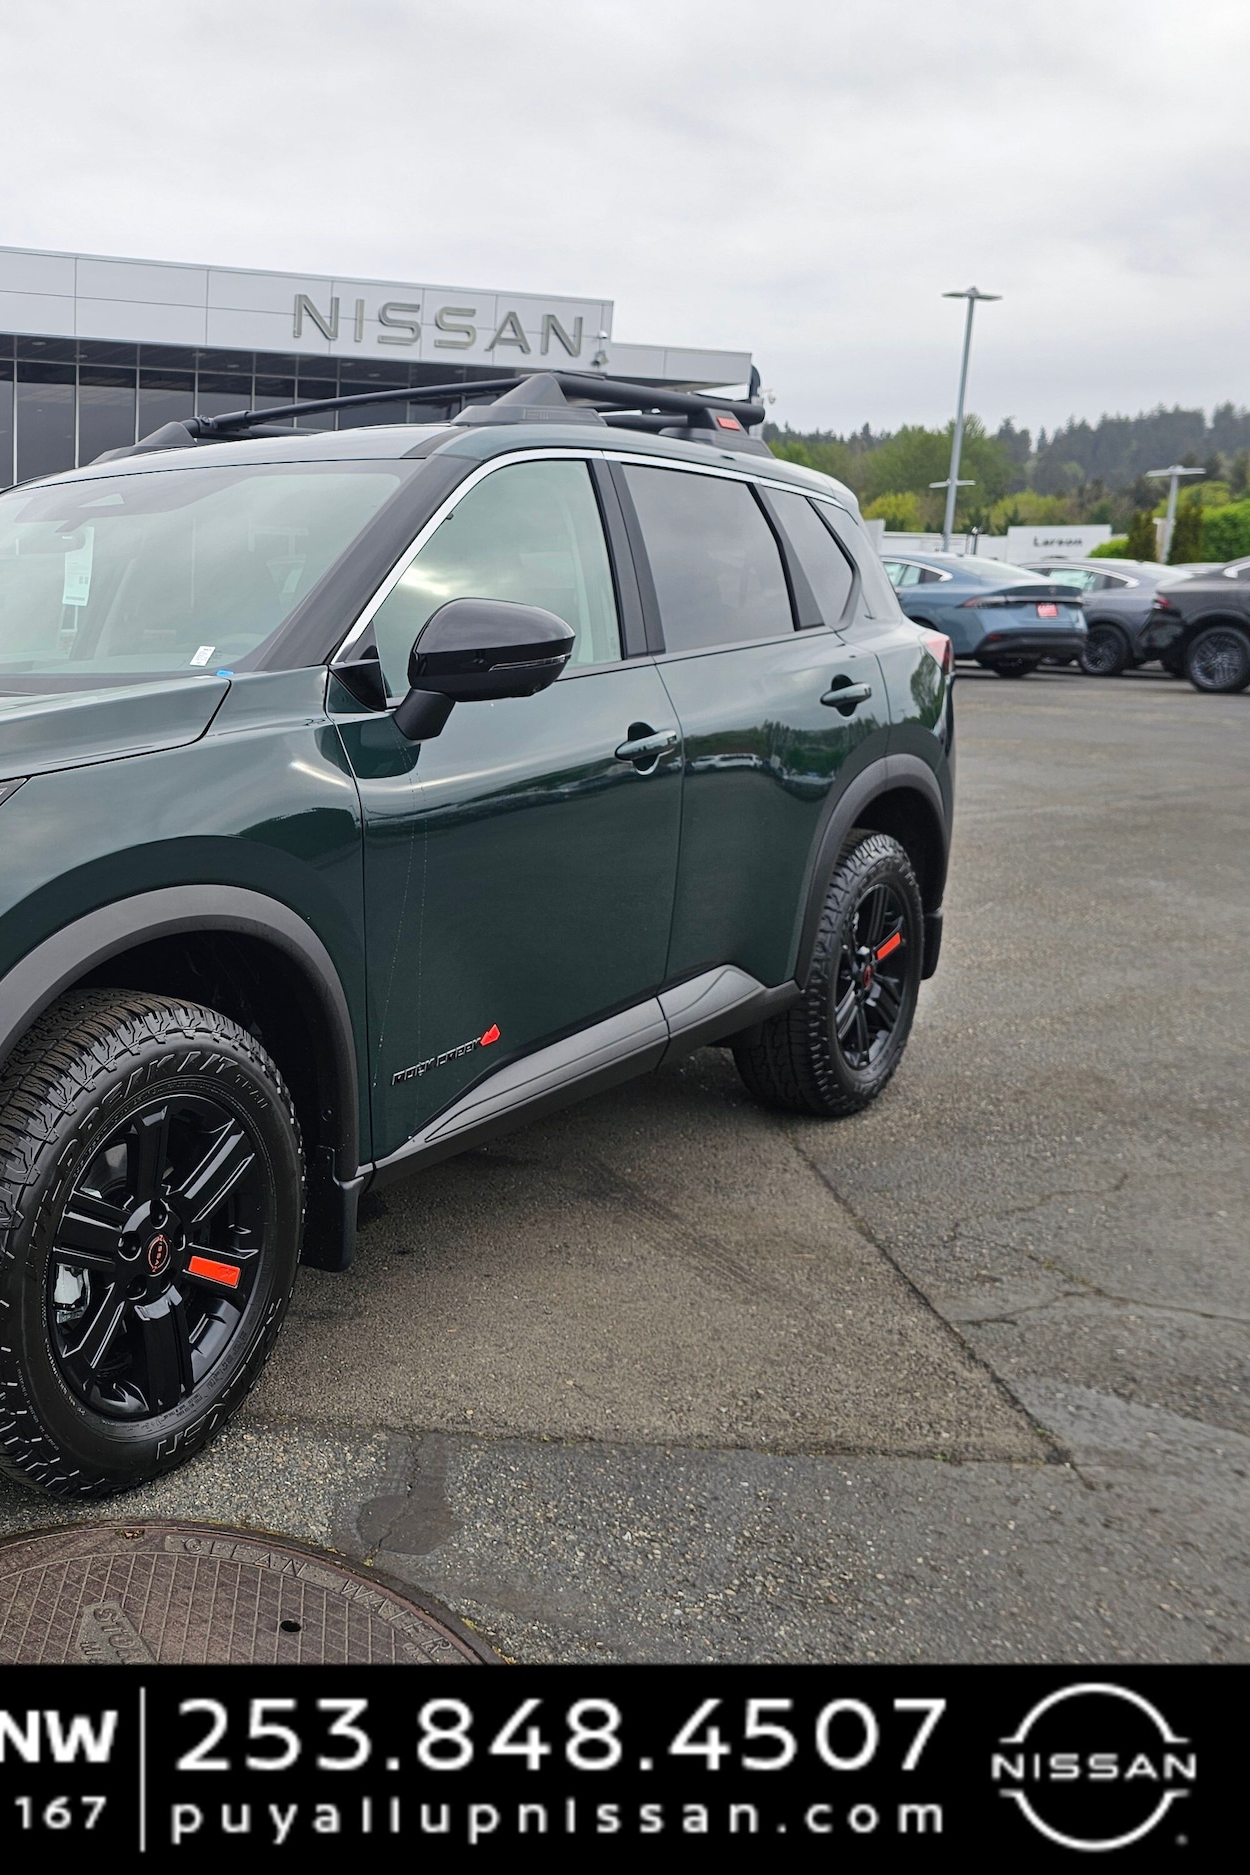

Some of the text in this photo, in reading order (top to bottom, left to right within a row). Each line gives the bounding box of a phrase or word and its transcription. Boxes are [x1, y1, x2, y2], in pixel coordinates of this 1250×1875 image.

[293, 293, 584, 358] NISSAN
[184, 1537, 452, 1655] CLEAN WATER
